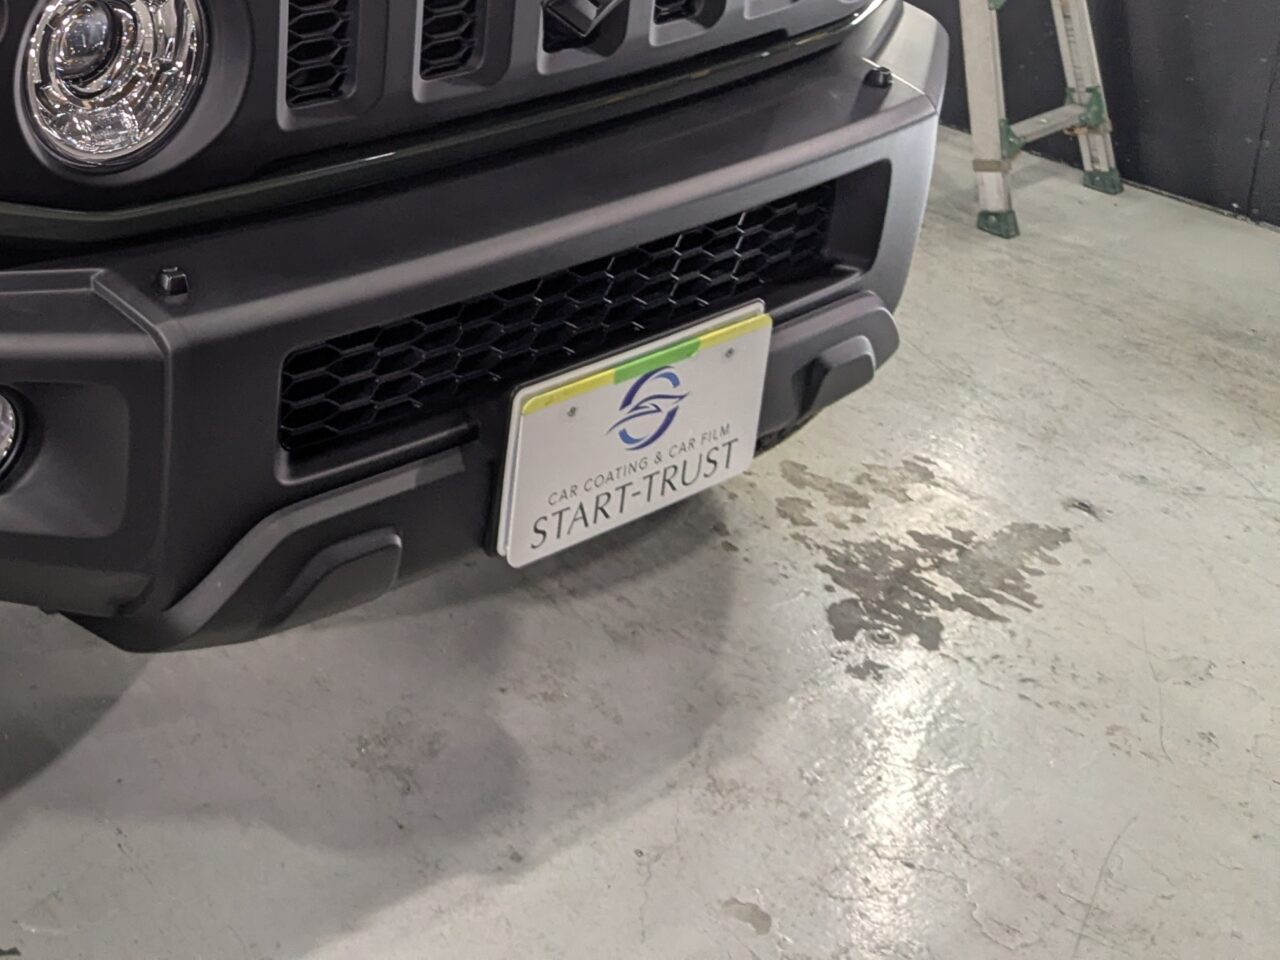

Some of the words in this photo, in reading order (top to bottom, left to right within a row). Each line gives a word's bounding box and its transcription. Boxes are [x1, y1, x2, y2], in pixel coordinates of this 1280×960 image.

[530, 438, 738, 549] START-TRUST
[548, 484, 578, 506] CAR
[583, 456, 648, 492] COATING
[654, 451, 662, 465] &
[669, 437, 696, 458] CAR
[700, 423, 730, 445] FILM
